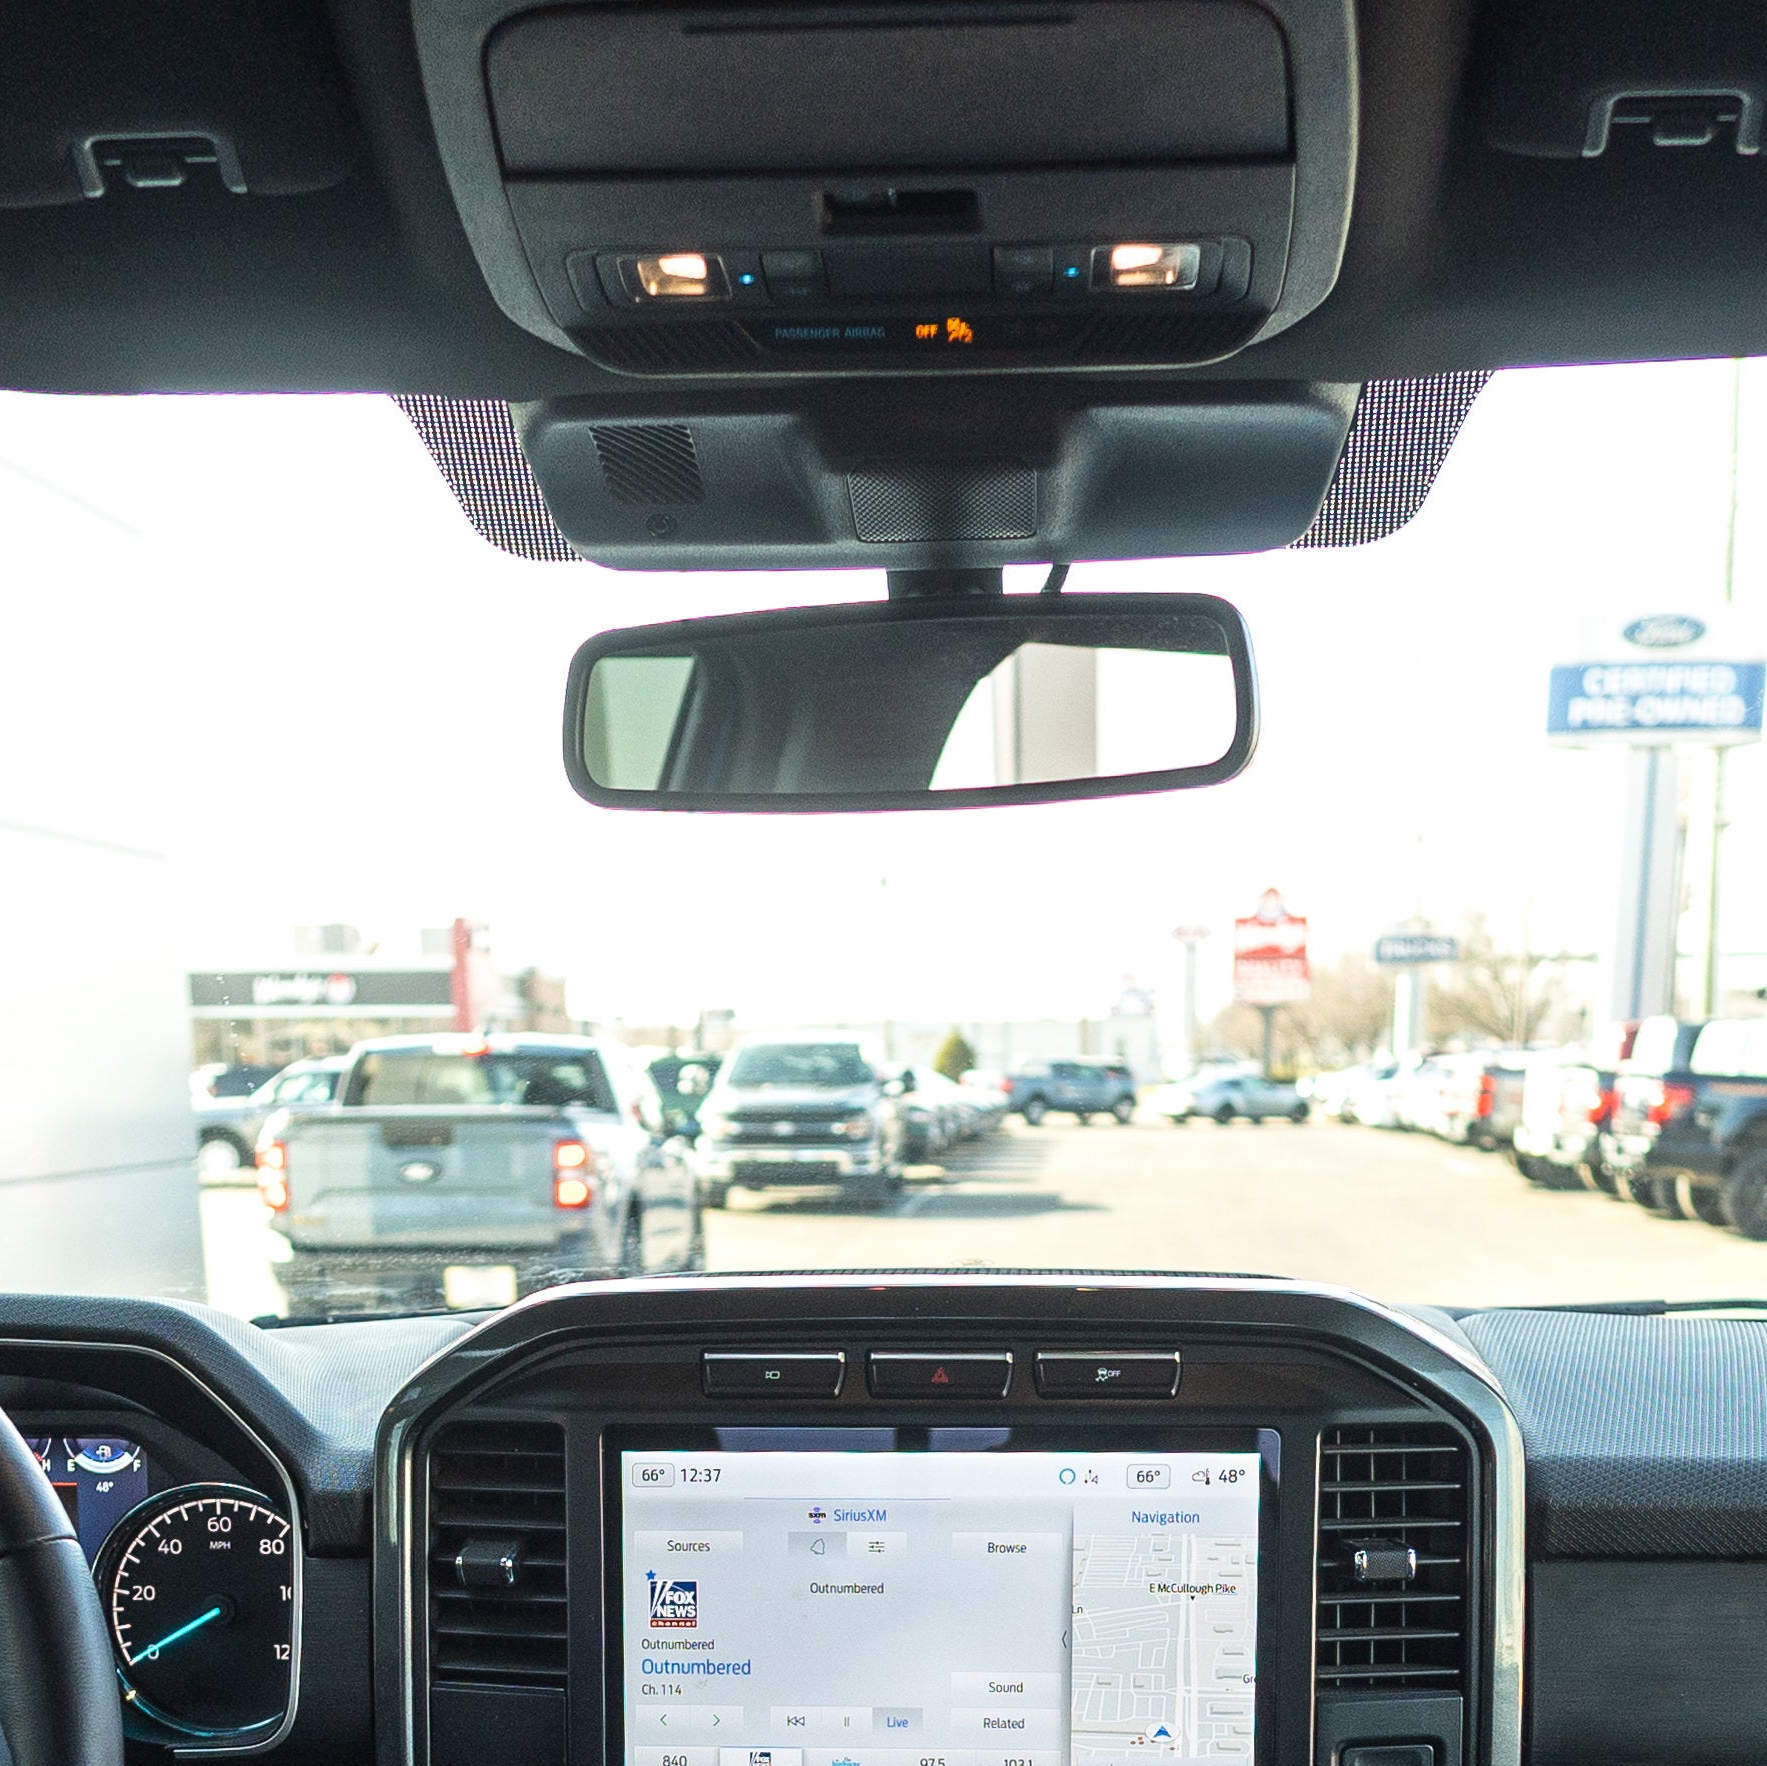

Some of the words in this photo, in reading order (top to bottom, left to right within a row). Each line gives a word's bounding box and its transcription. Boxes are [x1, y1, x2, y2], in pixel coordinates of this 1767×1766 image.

[915, 324, 939, 339] OFF
[67, 1459, 75, 1471] E
[133, 1459, 141, 1471] F
[641, 1468, 665, 1483] 66°
[680, 1468, 722, 1483] 12:37
[1136, 1469, 1161, 1484] 66°
[1218, 1468, 1246, 1484] 48°
[833, 1509, 887, 1522] SiriusXM
[1131, 1510, 1201, 1526] Navigation
[207, 1516, 232, 1532] 60
[157, 1539, 182, 1555] 40
[210, 1541, 231, 1550] MPH
[259, 1539, 284, 1555] 80
[667, 1540, 711, 1552] Sources
[987, 1542, 1027, 1554] Browse
[132, 1585, 156, 1601] 20
[809, 1582, 885, 1594] Outnumbered
[1149, 1583, 1156, 1593] E
[1157, 1582, 1214, 1595] McCullough
[1216, 1583, 1237, 1594] Pike
[665, 1591, 696, 1604] FOX
[656, 1605, 696, 1618] NEWS
[641, 1638, 715, 1650] Outnumbered
[641, 1658, 751, 1676] Outnumbered
[641, 1684, 659, 1696] Ch.
[661, 1684, 682, 1696] 114
[988, 1681, 1024, 1693] Sound
[886, 1716, 909, 1728] Live
[983, 1717, 1025, 1730] Related
